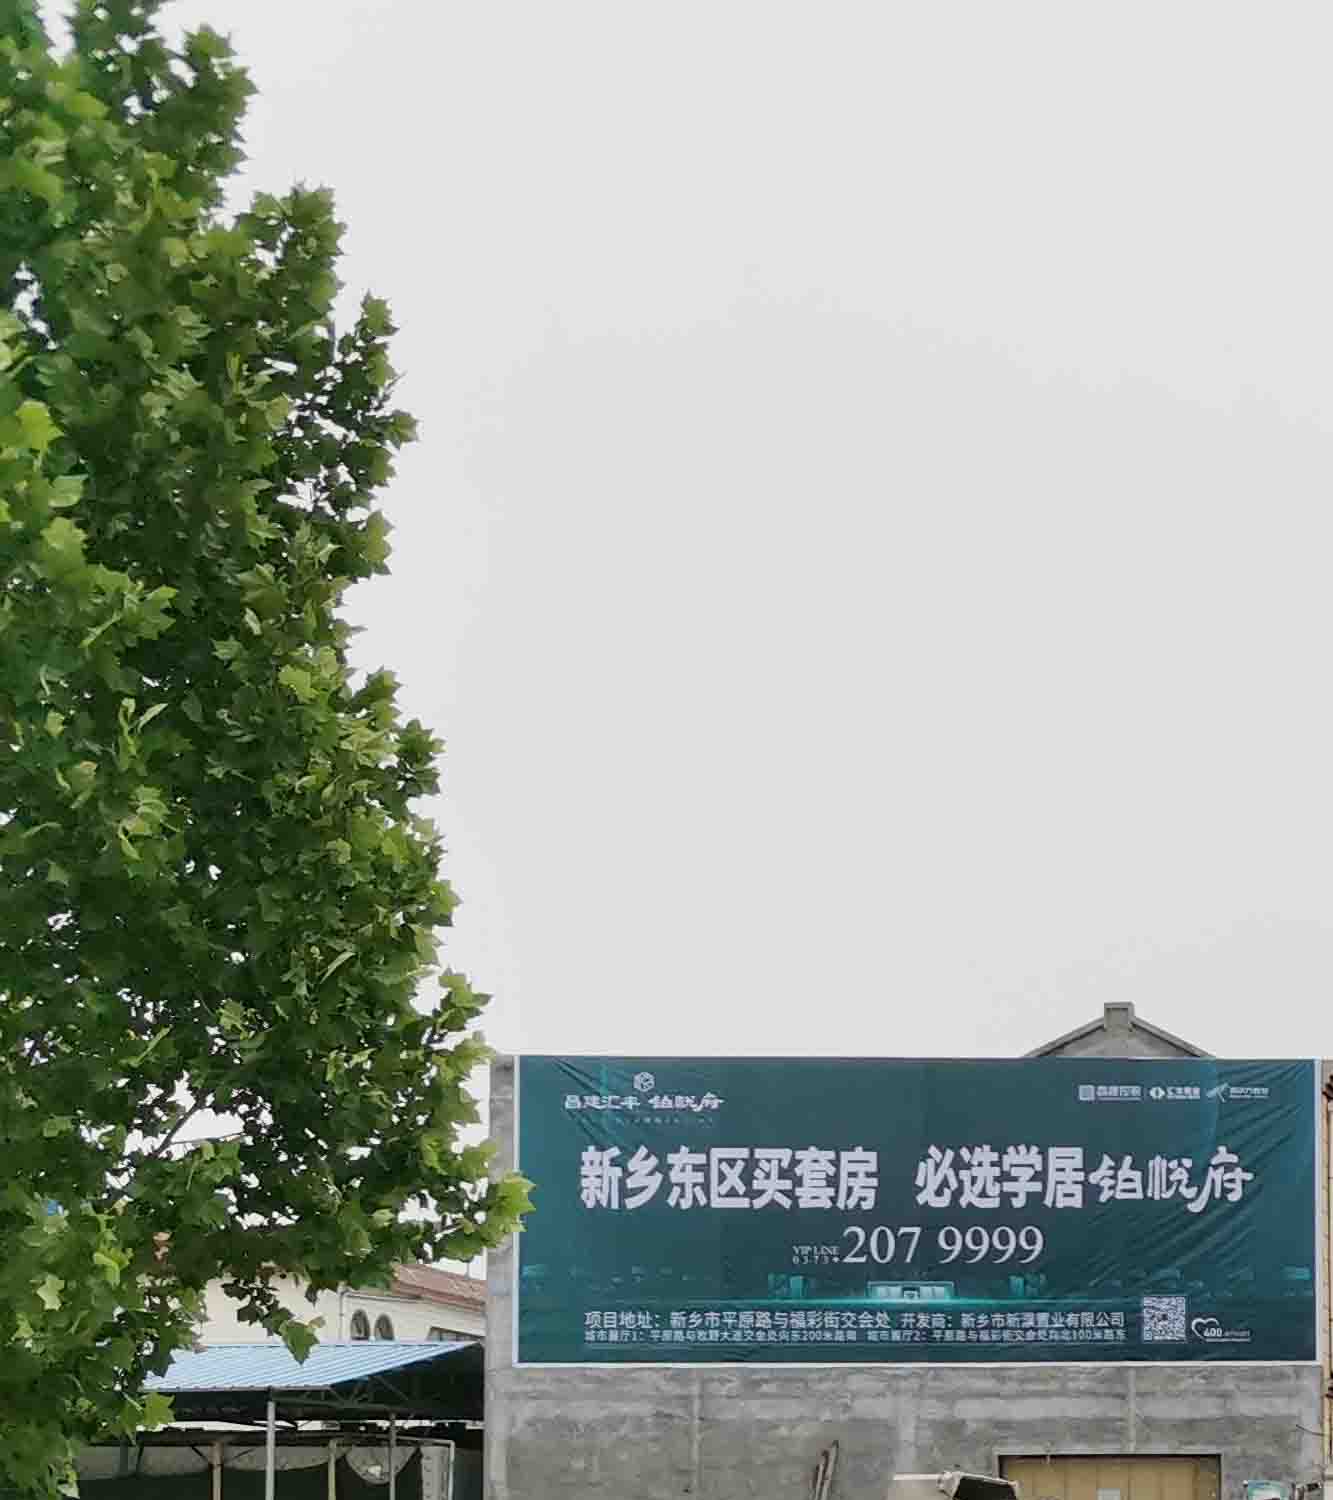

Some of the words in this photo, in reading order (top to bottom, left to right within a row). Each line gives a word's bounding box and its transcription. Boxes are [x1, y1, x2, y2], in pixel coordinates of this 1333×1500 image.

[579, 1144, 879, 1211] 新乡东区买套房
[842, 1225, 922, 1264] 207
[938, 1225, 1044, 1264] 9999
